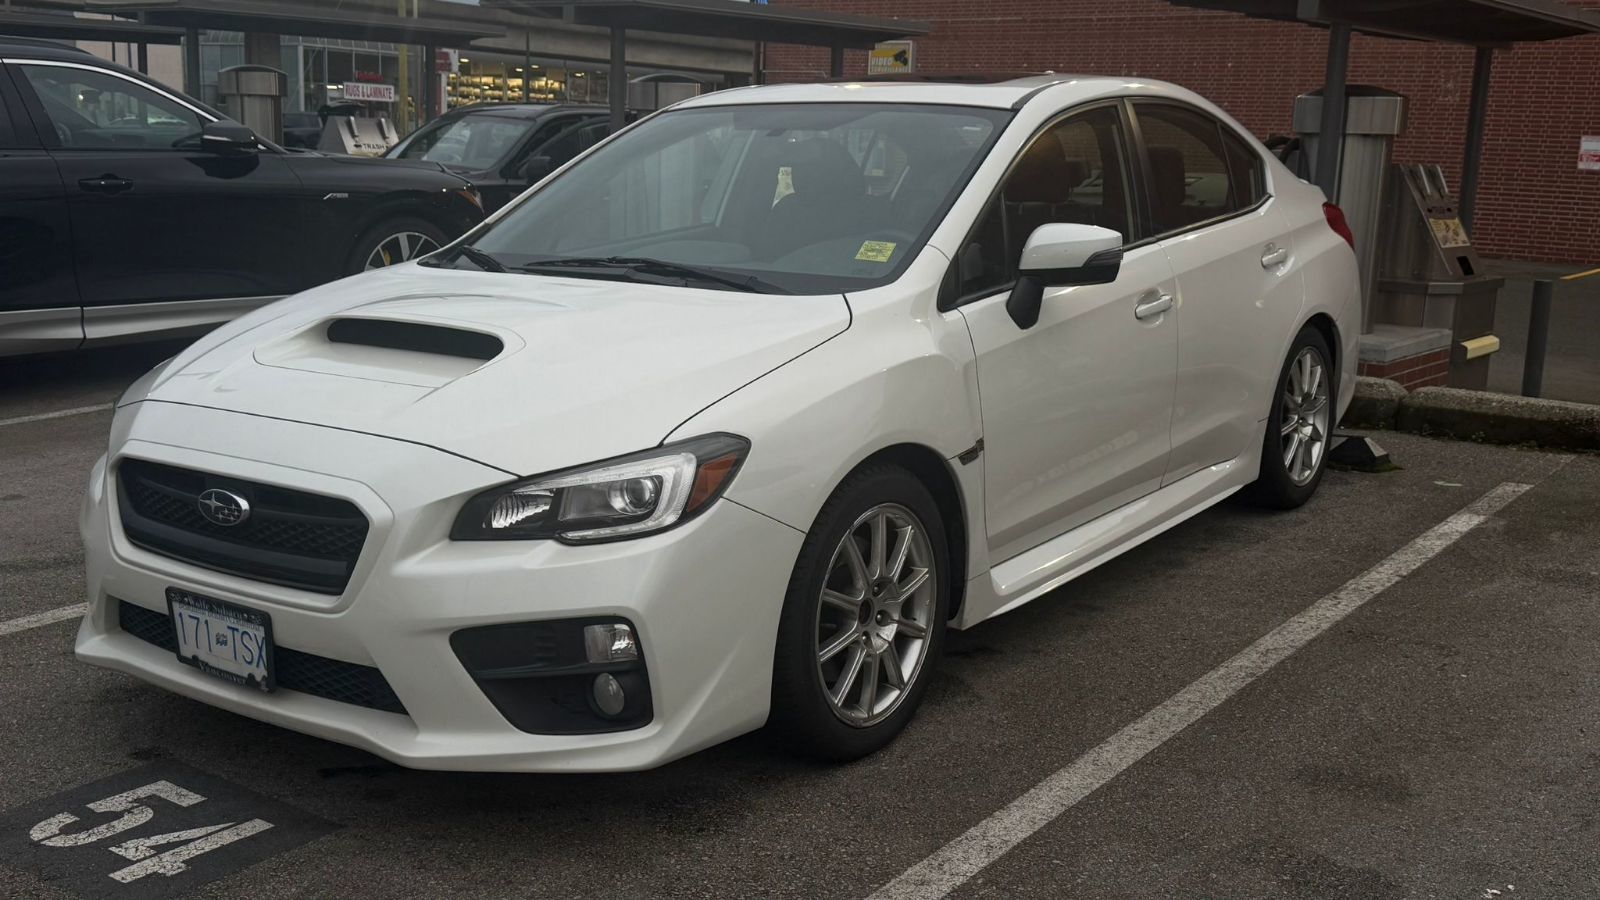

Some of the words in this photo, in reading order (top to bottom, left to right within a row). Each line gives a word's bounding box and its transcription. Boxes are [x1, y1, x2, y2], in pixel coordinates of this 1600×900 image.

[871, 56, 893, 65] VIDEO
[346, 84, 361, 97] RUGS
[361, 85, 366, 98] &
[366, 85, 392, 100] LAMINATE
[179, 611, 212, 653] 171
[227, 625, 267, 671] TSX
[29, 779, 275, 884] 54
